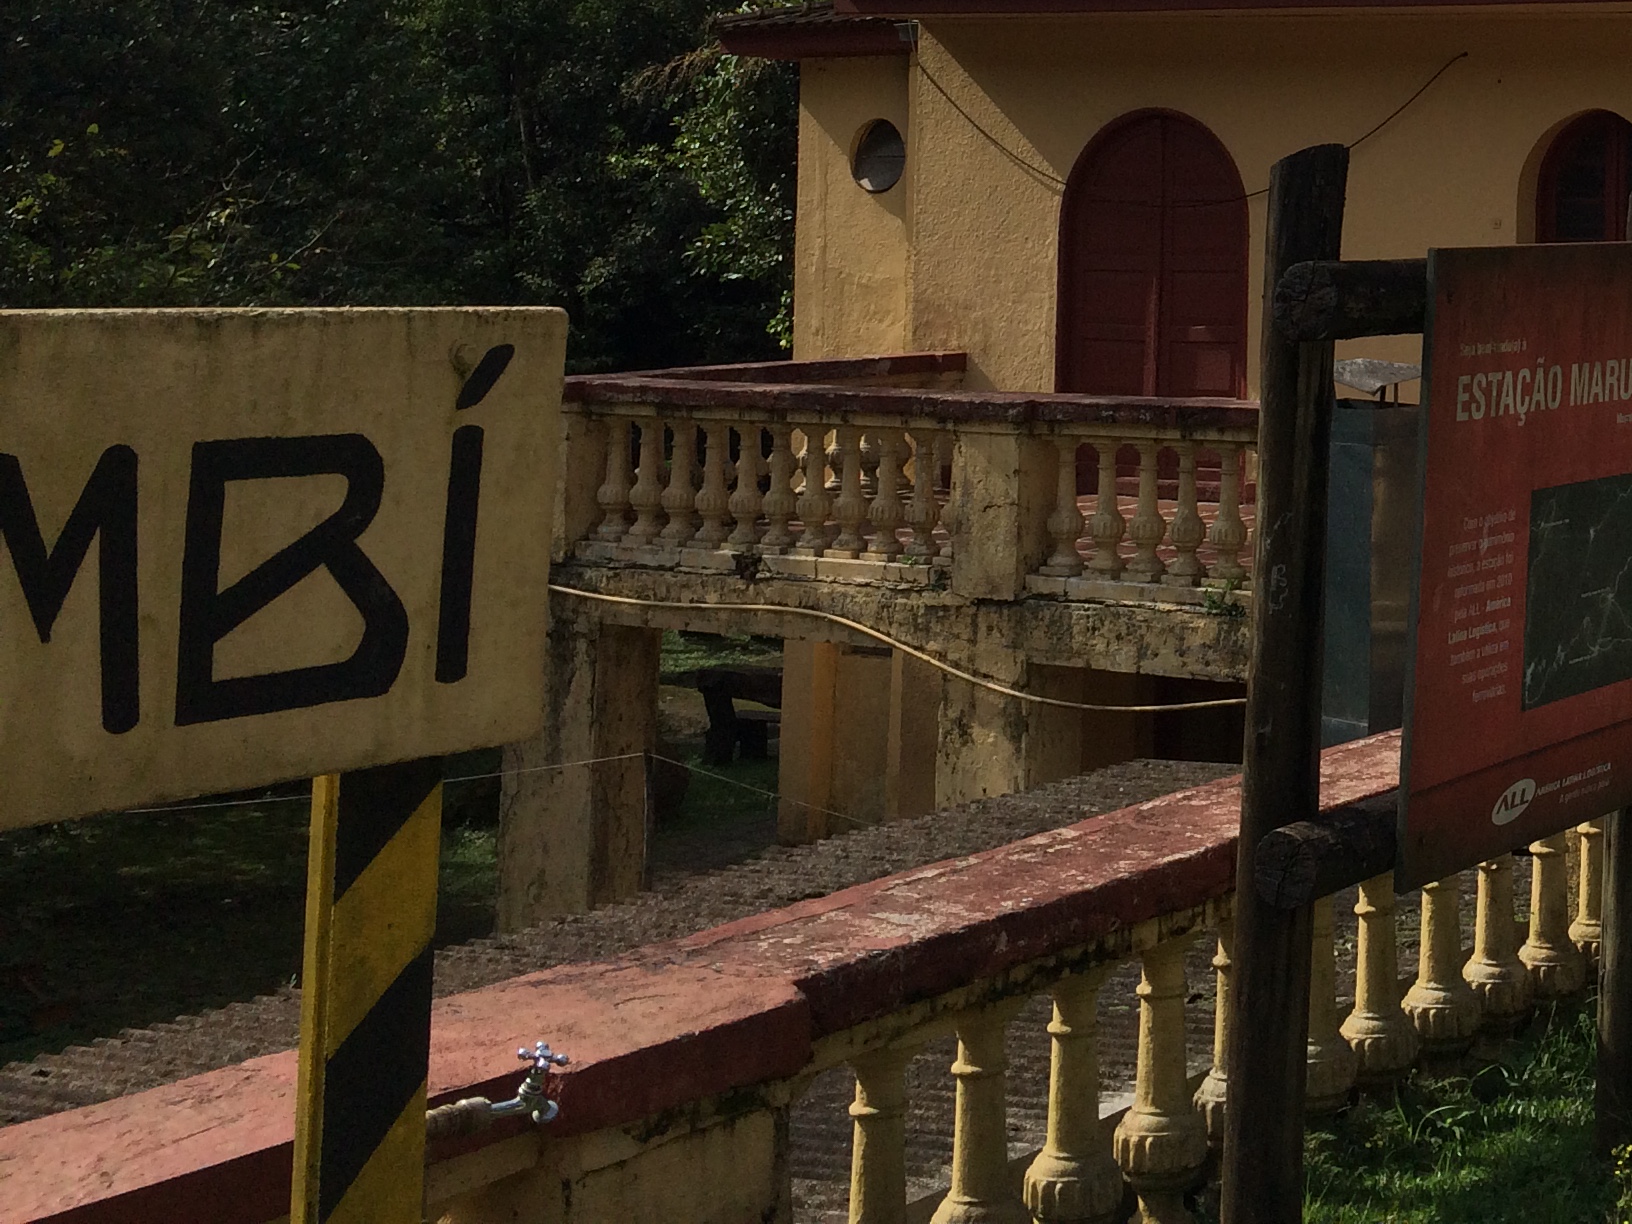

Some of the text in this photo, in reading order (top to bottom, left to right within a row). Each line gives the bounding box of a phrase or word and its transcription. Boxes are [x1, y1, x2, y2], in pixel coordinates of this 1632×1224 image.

[1456, 356, 1563, 426] ESTAÇÃO
[1448, 629, 1468, 644] Latina
[1496, 787, 1529, 815] ALL
